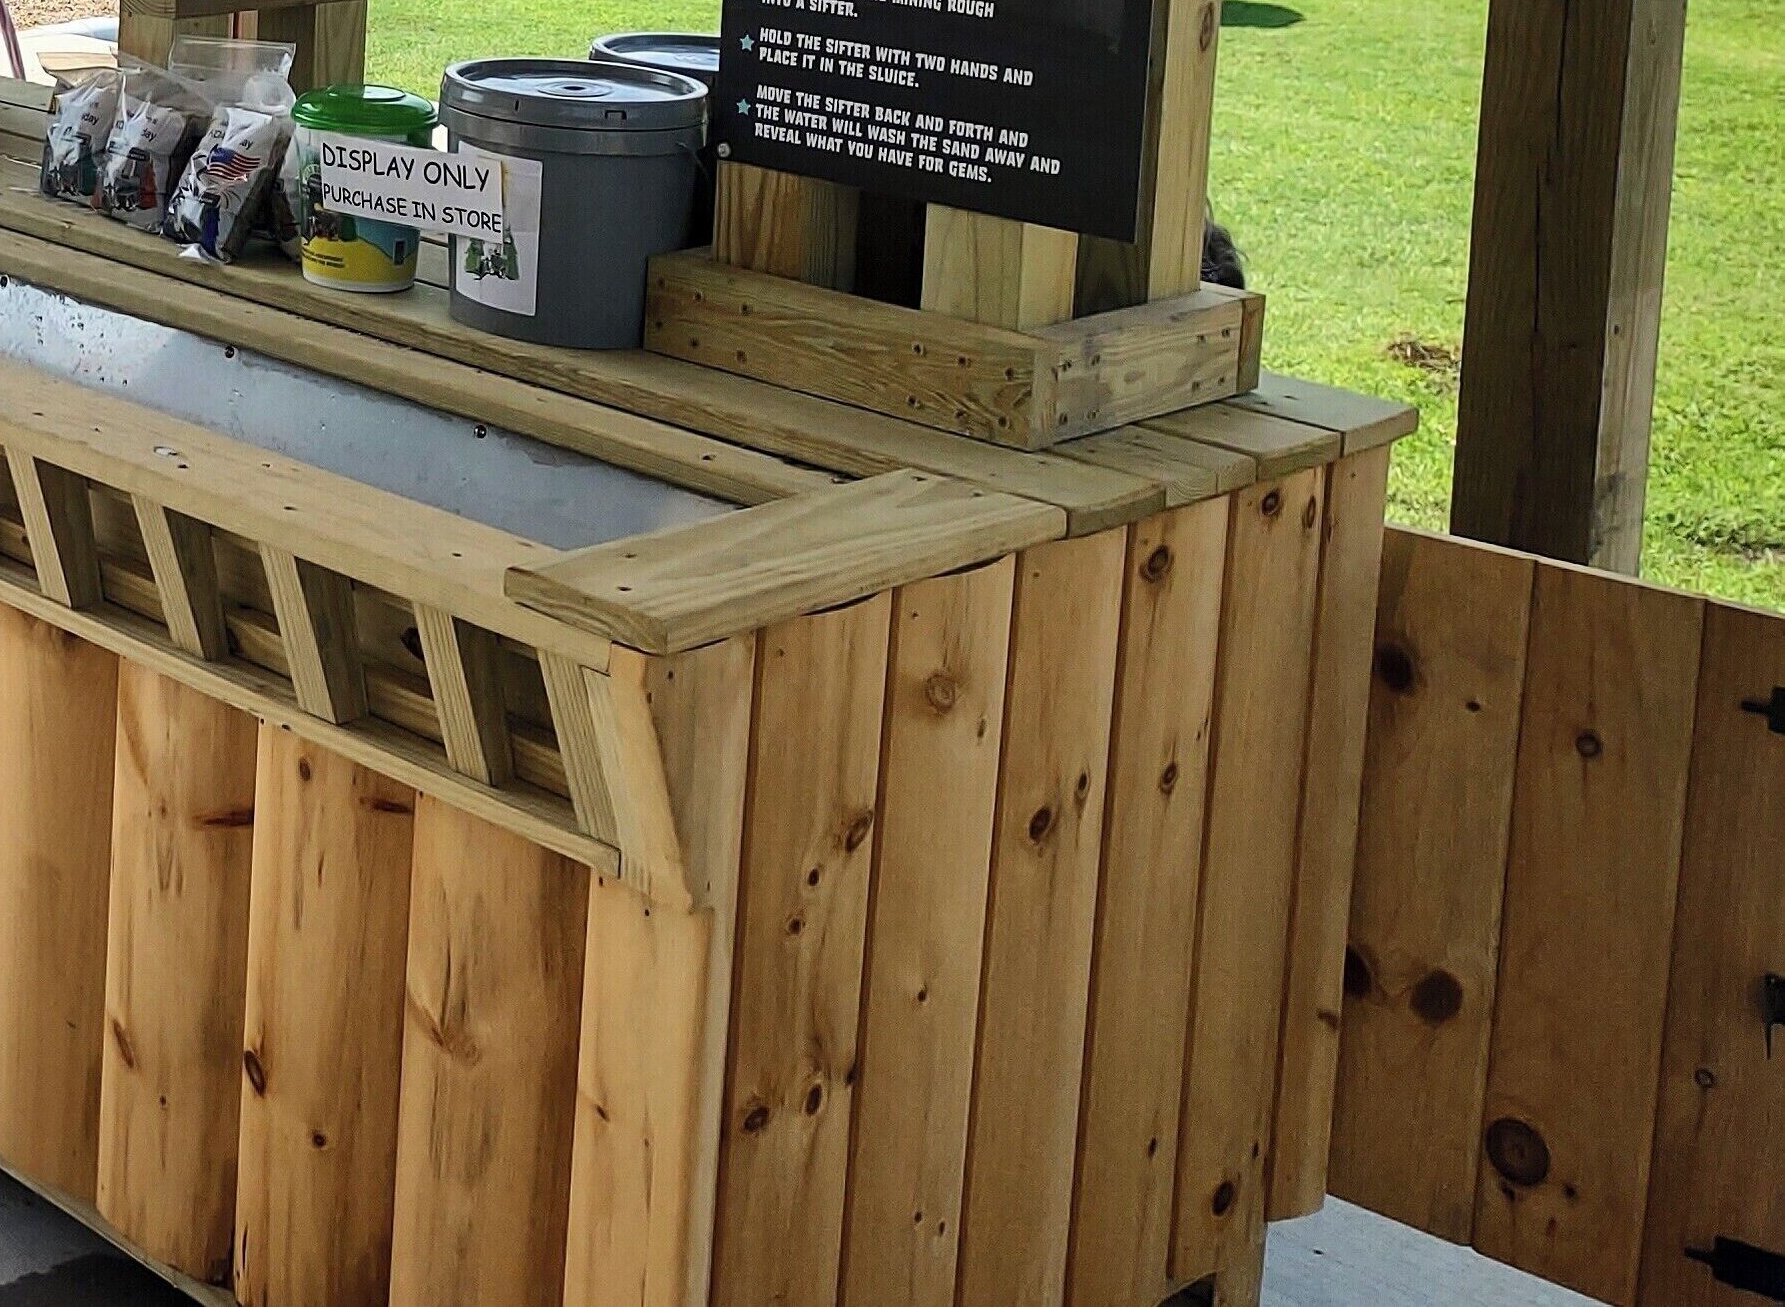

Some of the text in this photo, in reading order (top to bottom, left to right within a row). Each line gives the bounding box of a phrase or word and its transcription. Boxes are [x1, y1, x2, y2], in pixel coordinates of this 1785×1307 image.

[759, 47, 919, 88] PLACE IT IN THE SLUICE.
[760, 27, 1033, 86] HOLD THE SIFTER WITH TWO HANDS AND
[756, 103, 1060, 175] THE WATER WILL WASH THE SAND AWAY AND
[757, 84, 1028, 147] MOVE THE SIFTER BACK AND FORTH AND
[322, 142, 415, 180] DISPLAY
[424, 161, 489, 192] ONLY
[755, 123, 992, 182] REVEAL WHAT YOU HAVE FOR GEMS.
[323, 183, 501, 233] PURCHASE IN STORE
